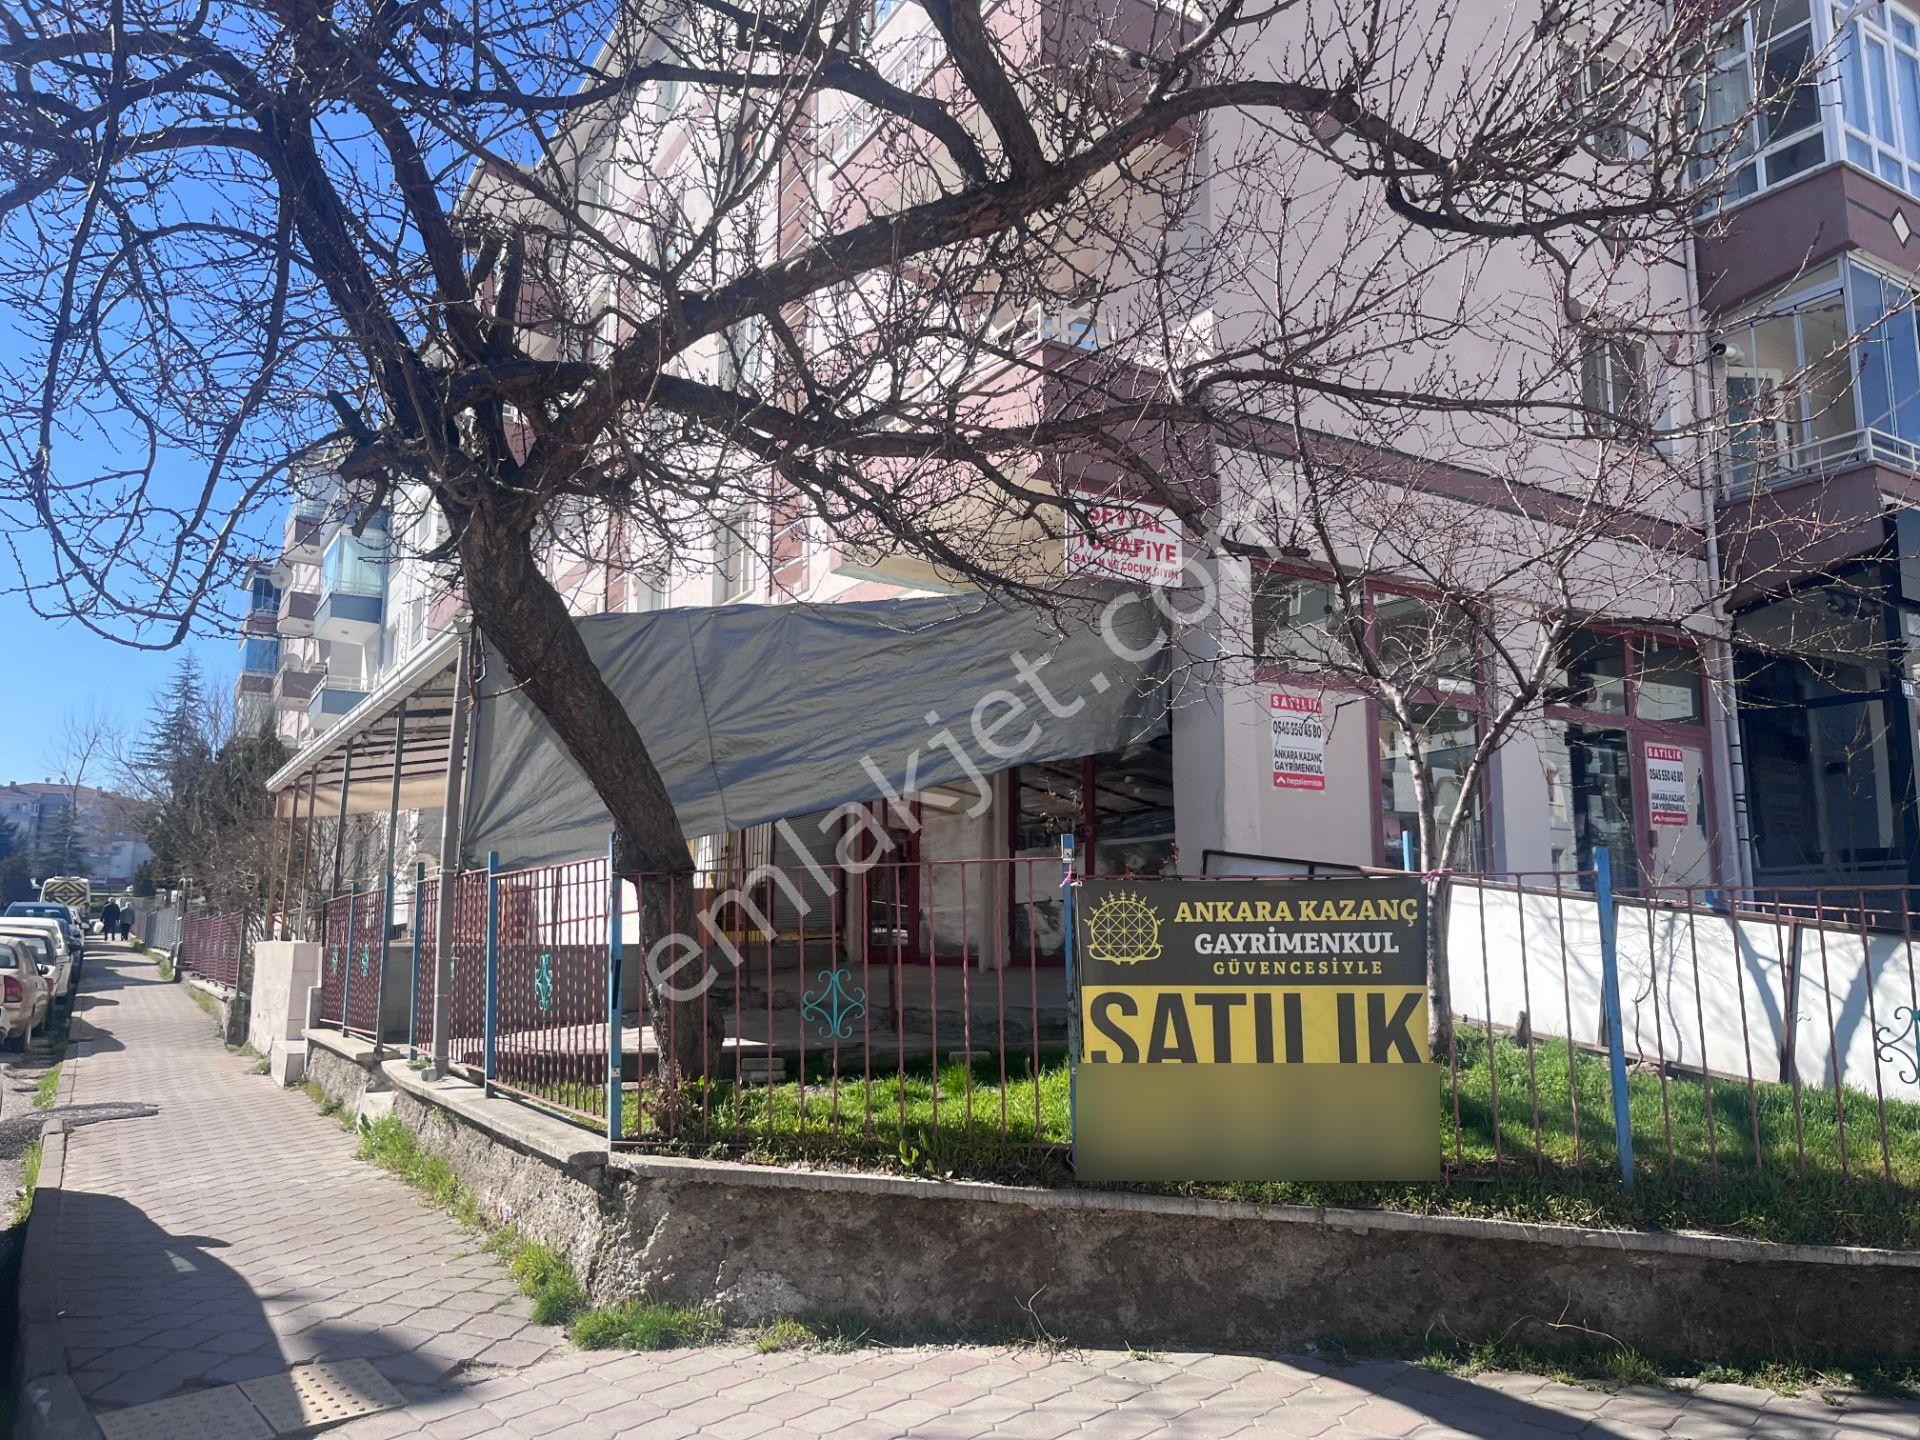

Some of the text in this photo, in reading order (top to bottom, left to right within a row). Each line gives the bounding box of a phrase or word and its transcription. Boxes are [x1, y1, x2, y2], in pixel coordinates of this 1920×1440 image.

[1272, 695, 1321, 713] SATILIK
[1274, 749, 1298, 761] ANKARA
[1648, 747, 1682, 760] SATILIK
[1174, 898, 1418, 927] ANKARA KAZANÇ
[1194, 926, 1400, 955] GAYRİMENKUL
[1213, 957, 1383, 975] GÜVENCESİYLE
